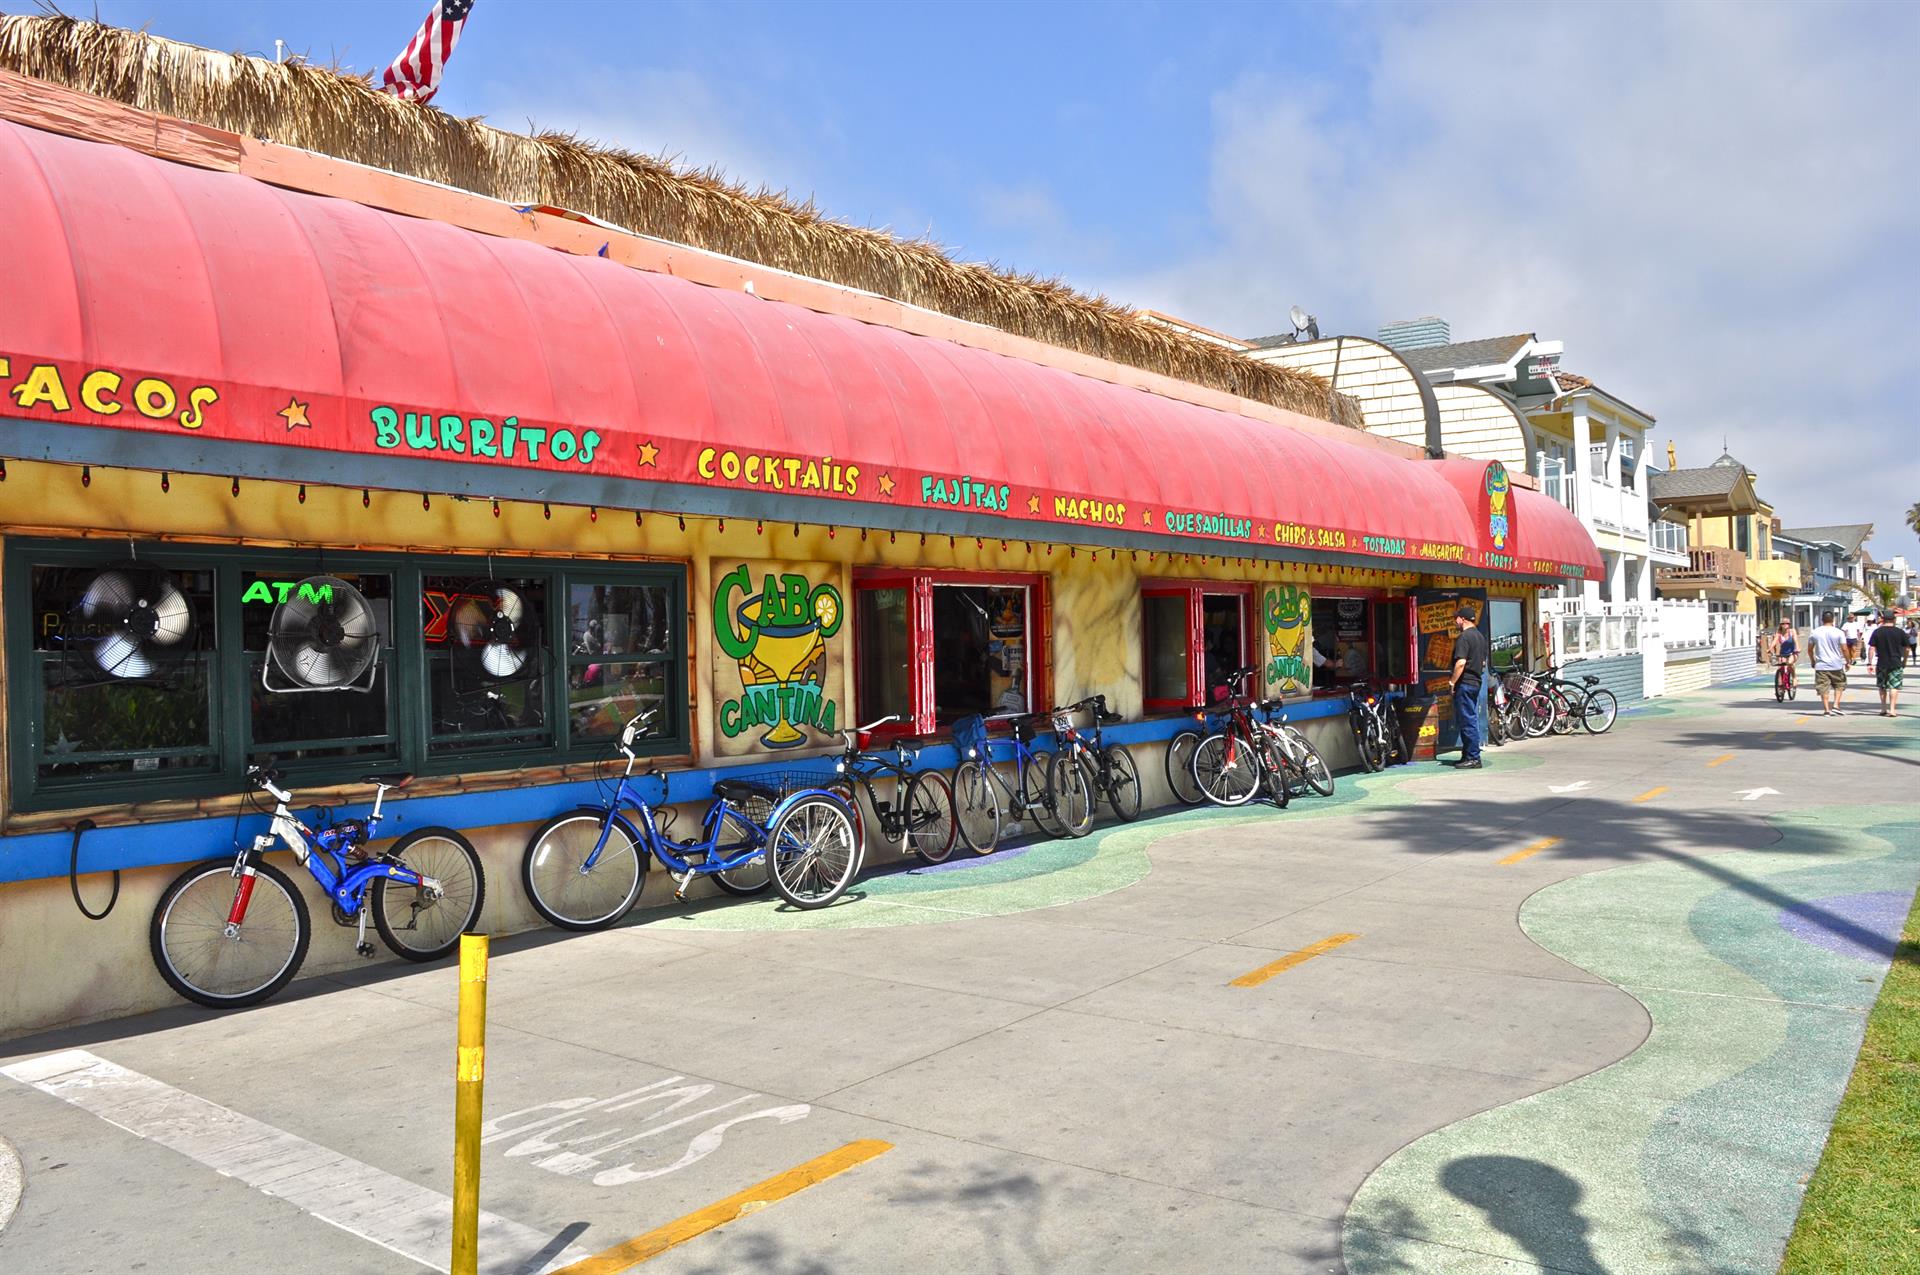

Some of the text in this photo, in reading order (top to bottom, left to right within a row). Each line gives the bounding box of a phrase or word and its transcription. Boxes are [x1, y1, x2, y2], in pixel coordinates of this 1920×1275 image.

[0, 357, 219, 430] ACOS
[1054, 495, 1126, 525] NACHOS
[1308, 531, 1316, 546] &
[1317, 528, 1346, 548] SALSA
[1363, 535, 1406, 556] TOSTADAS
[1485, 551, 1513, 570] SPORTS
[1533, 560, 1553, 574] TACOS
[241, 581, 333, 605] ATM
[713, 564, 844, 660] CABO
[1264, 585, 1312, 634] CABO
[1266, 657, 1311, 689] CANTINA
[719, 687, 836, 738] CANTINA
